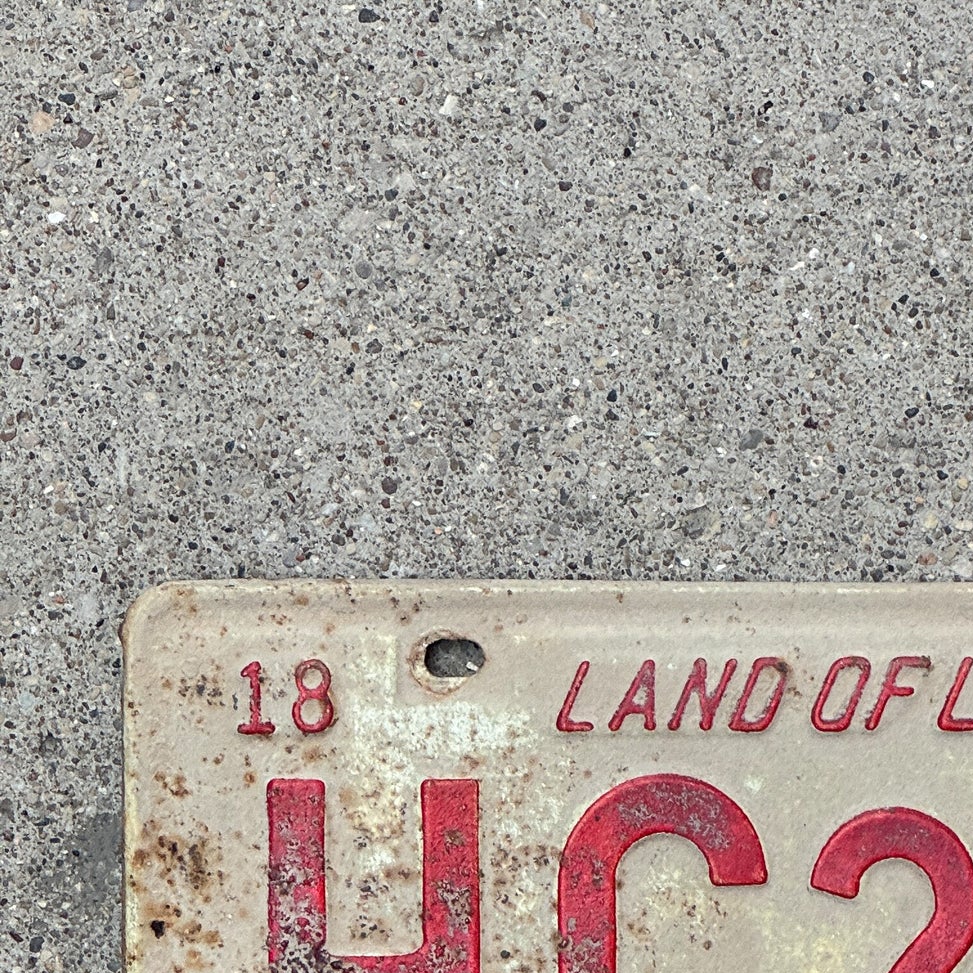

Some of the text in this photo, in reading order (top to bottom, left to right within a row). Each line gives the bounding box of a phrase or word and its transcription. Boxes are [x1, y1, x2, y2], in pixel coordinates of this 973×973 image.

[237, 659, 336, 736] 18
[556, 657, 789, 733] LAND
[811, 655, 931, 732] OF
